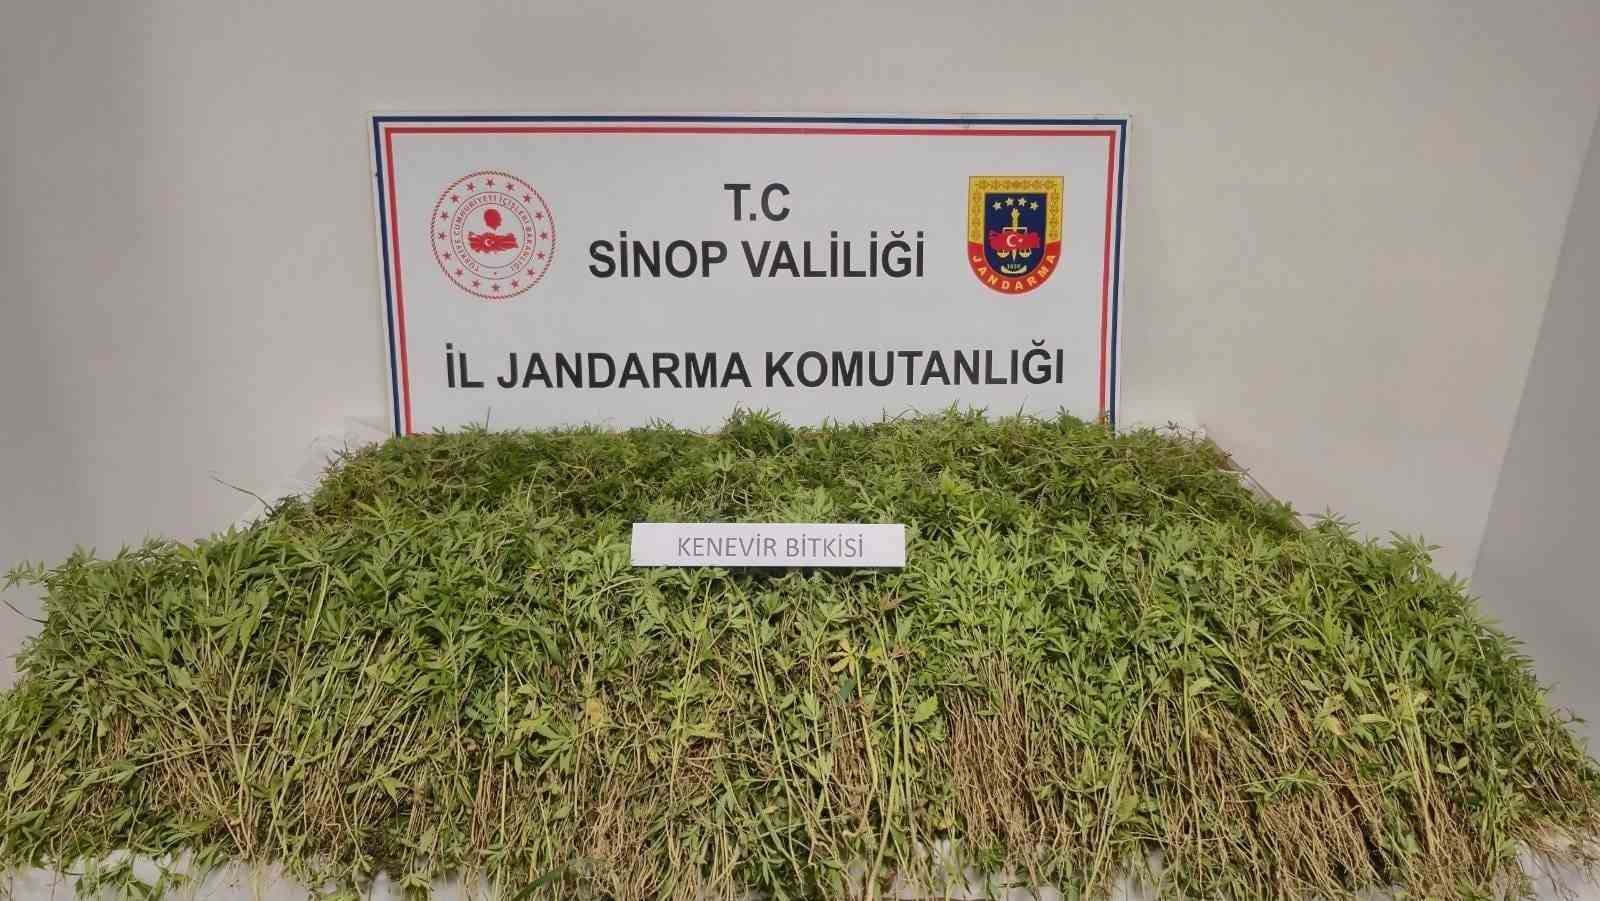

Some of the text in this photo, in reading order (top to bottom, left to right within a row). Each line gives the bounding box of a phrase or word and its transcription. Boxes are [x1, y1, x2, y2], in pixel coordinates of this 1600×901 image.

[724, 183, 789, 221] T.C
[589, 231, 923, 278] SİNOP VALİLİĞİ
[972, 255, 1056, 291] JANDARMA
[446, 340, 1063, 388] İL JANDARMA KOMUTANLIĞI
[678, 533, 863, 558] KENEVİR BİTKİSİ
